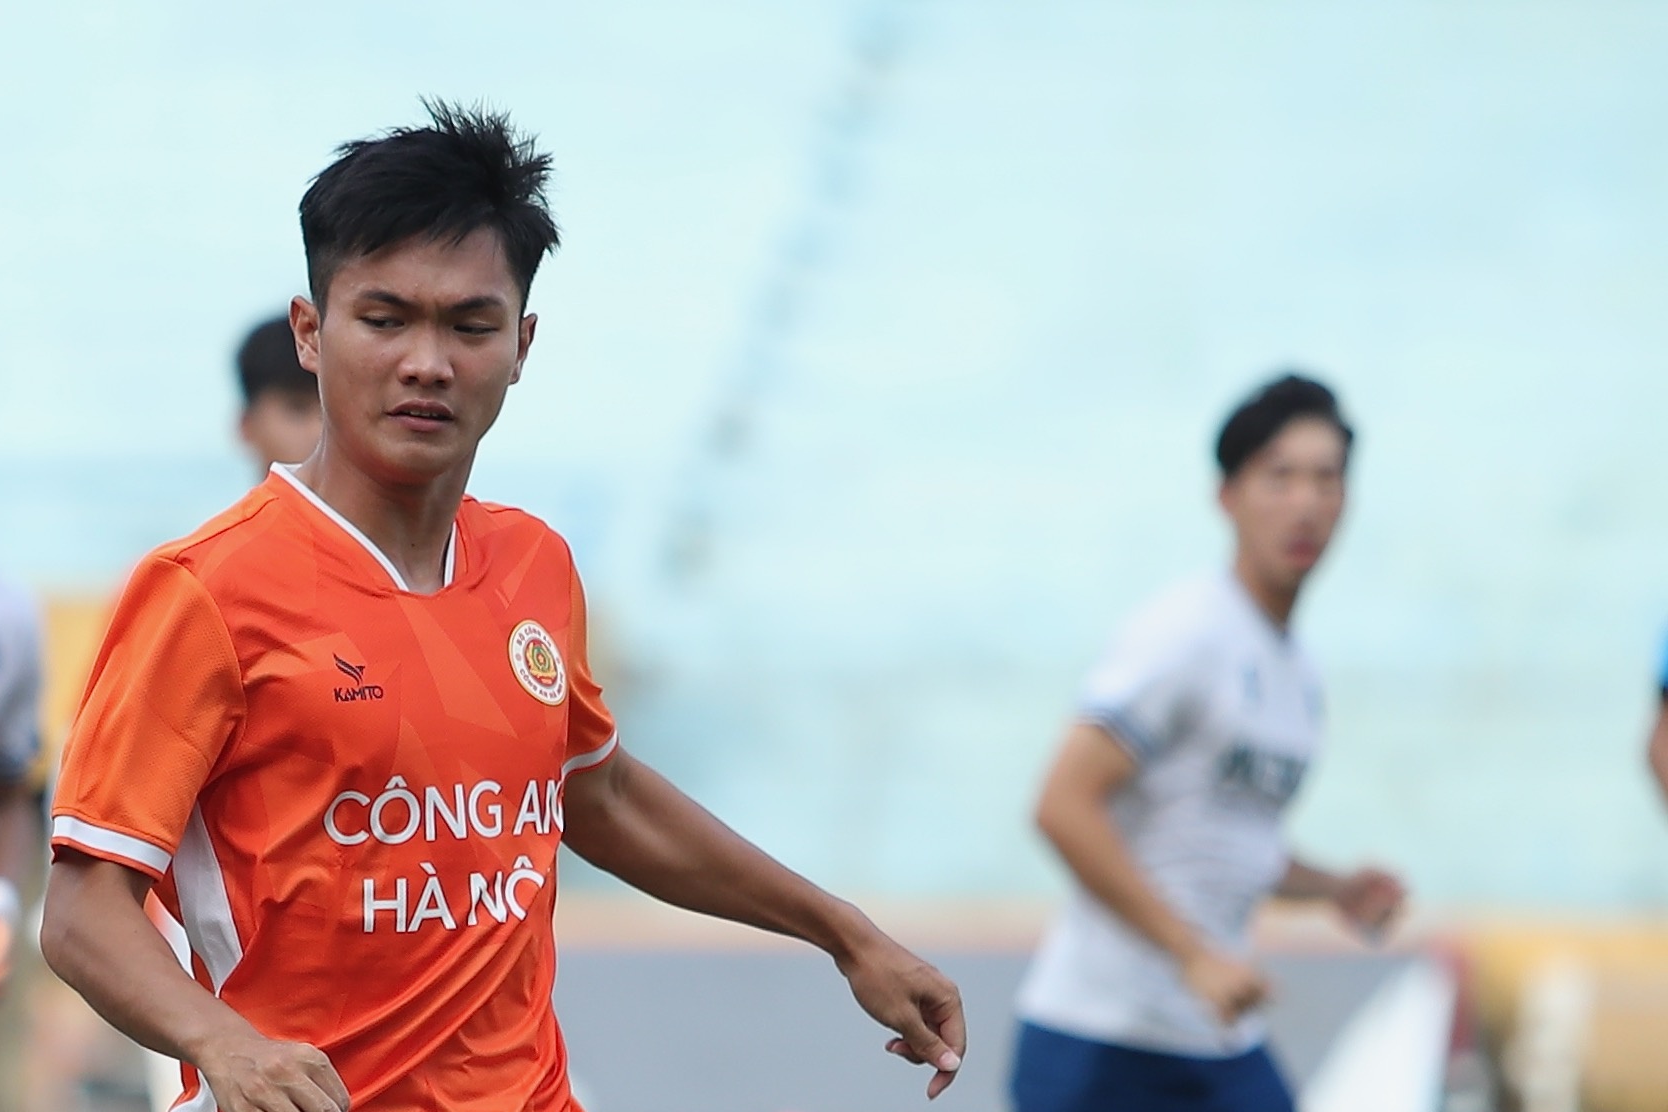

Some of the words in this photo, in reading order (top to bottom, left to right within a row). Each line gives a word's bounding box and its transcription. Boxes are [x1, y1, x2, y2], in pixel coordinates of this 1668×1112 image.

[333, 685, 384, 702] KAMITO
[323, 774, 503, 845] CÔNG
[512, 779, 564, 836] AN
[363, 861, 457, 933] HÀ
